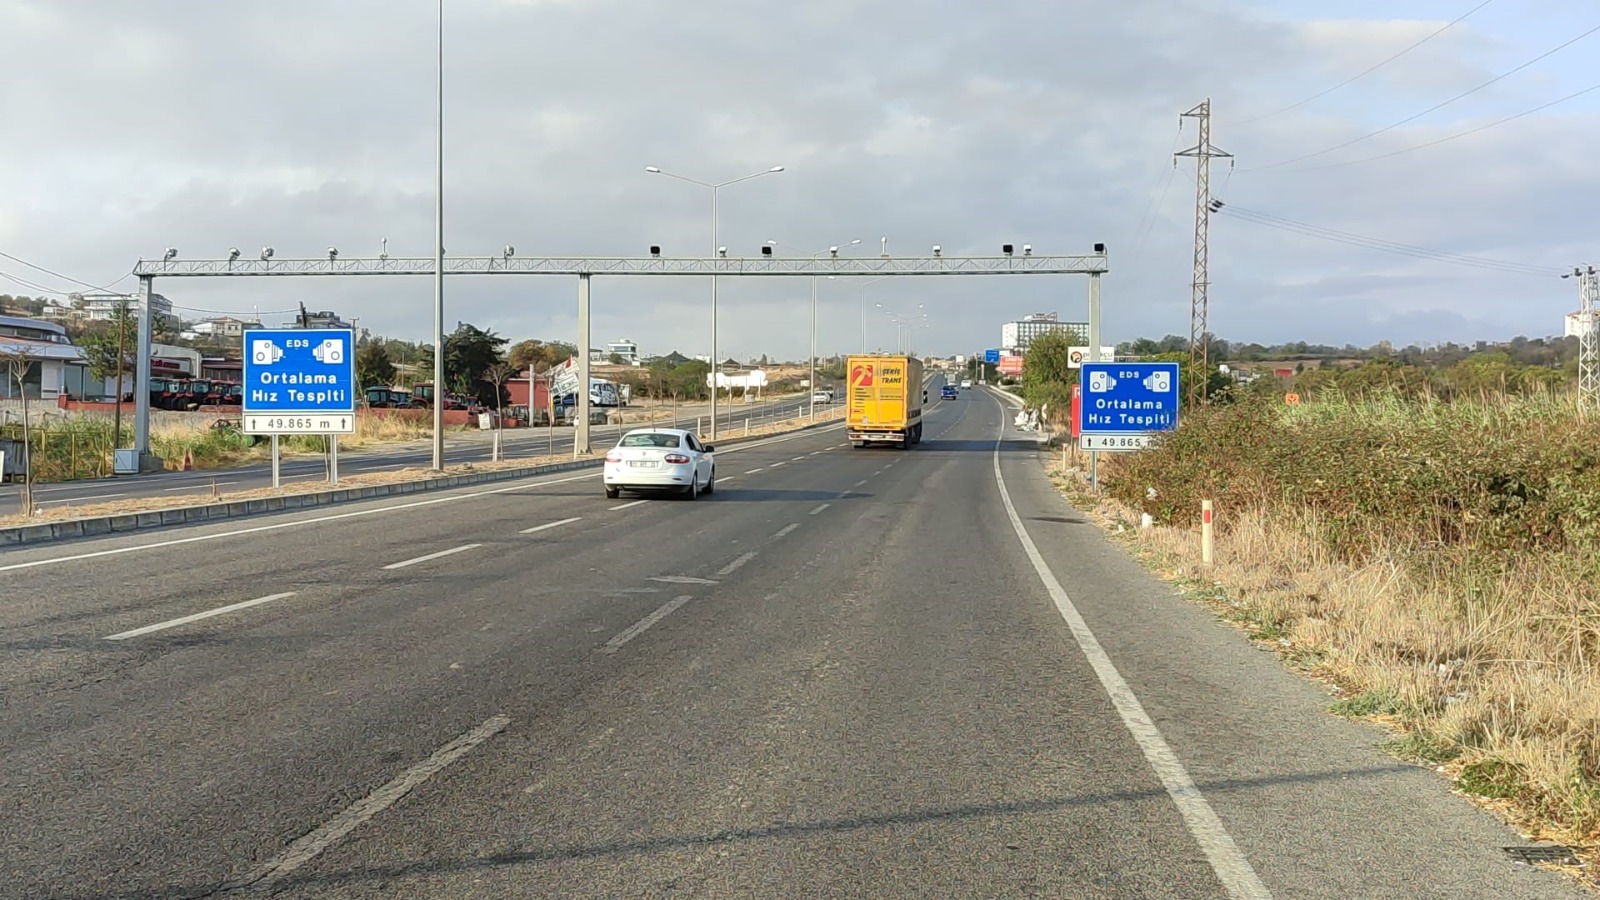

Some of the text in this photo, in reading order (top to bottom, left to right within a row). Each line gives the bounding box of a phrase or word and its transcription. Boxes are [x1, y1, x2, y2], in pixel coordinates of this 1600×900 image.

[286, 339, 309, 348] EDS
[260, 372, 337, 384] Ortalama
[1119, 371, 1140, 379] EDS
[252, 389, 345, 404] Hız Tespiti
[1096, 398, 1163, 409] Ortalama
[268, 419, 330, 428] 49.865 m
[1088, 413, 1170, 426] Hız Tespiti
[1101, 438, 1141, 447] 49.865
